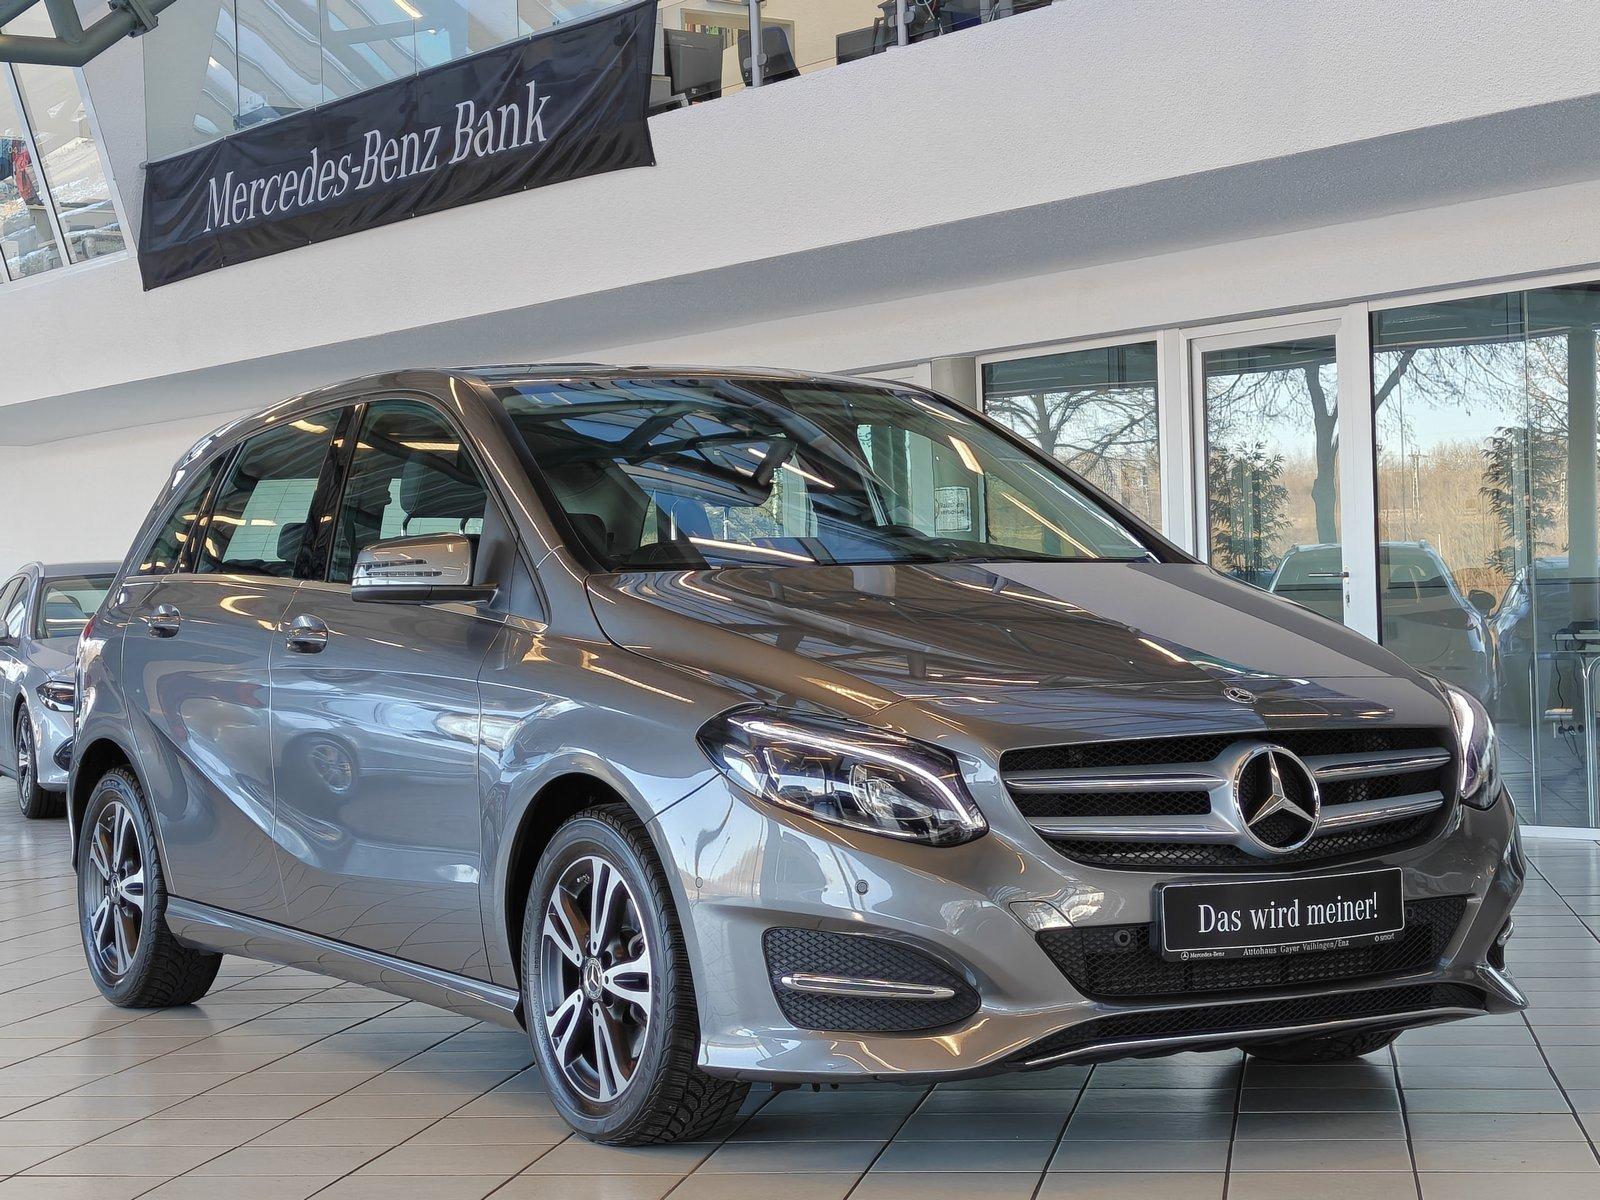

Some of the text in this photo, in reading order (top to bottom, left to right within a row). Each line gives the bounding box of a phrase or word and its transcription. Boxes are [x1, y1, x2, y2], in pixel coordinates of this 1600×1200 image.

[203, 80, 551, 233] Mercedes-Benz Bank
[1198, 891, 1378, 933] Das wird meiner!
[1243, 947, 1277, 956] Autohaus
[1280, 945, 1300, 954] Gayer
